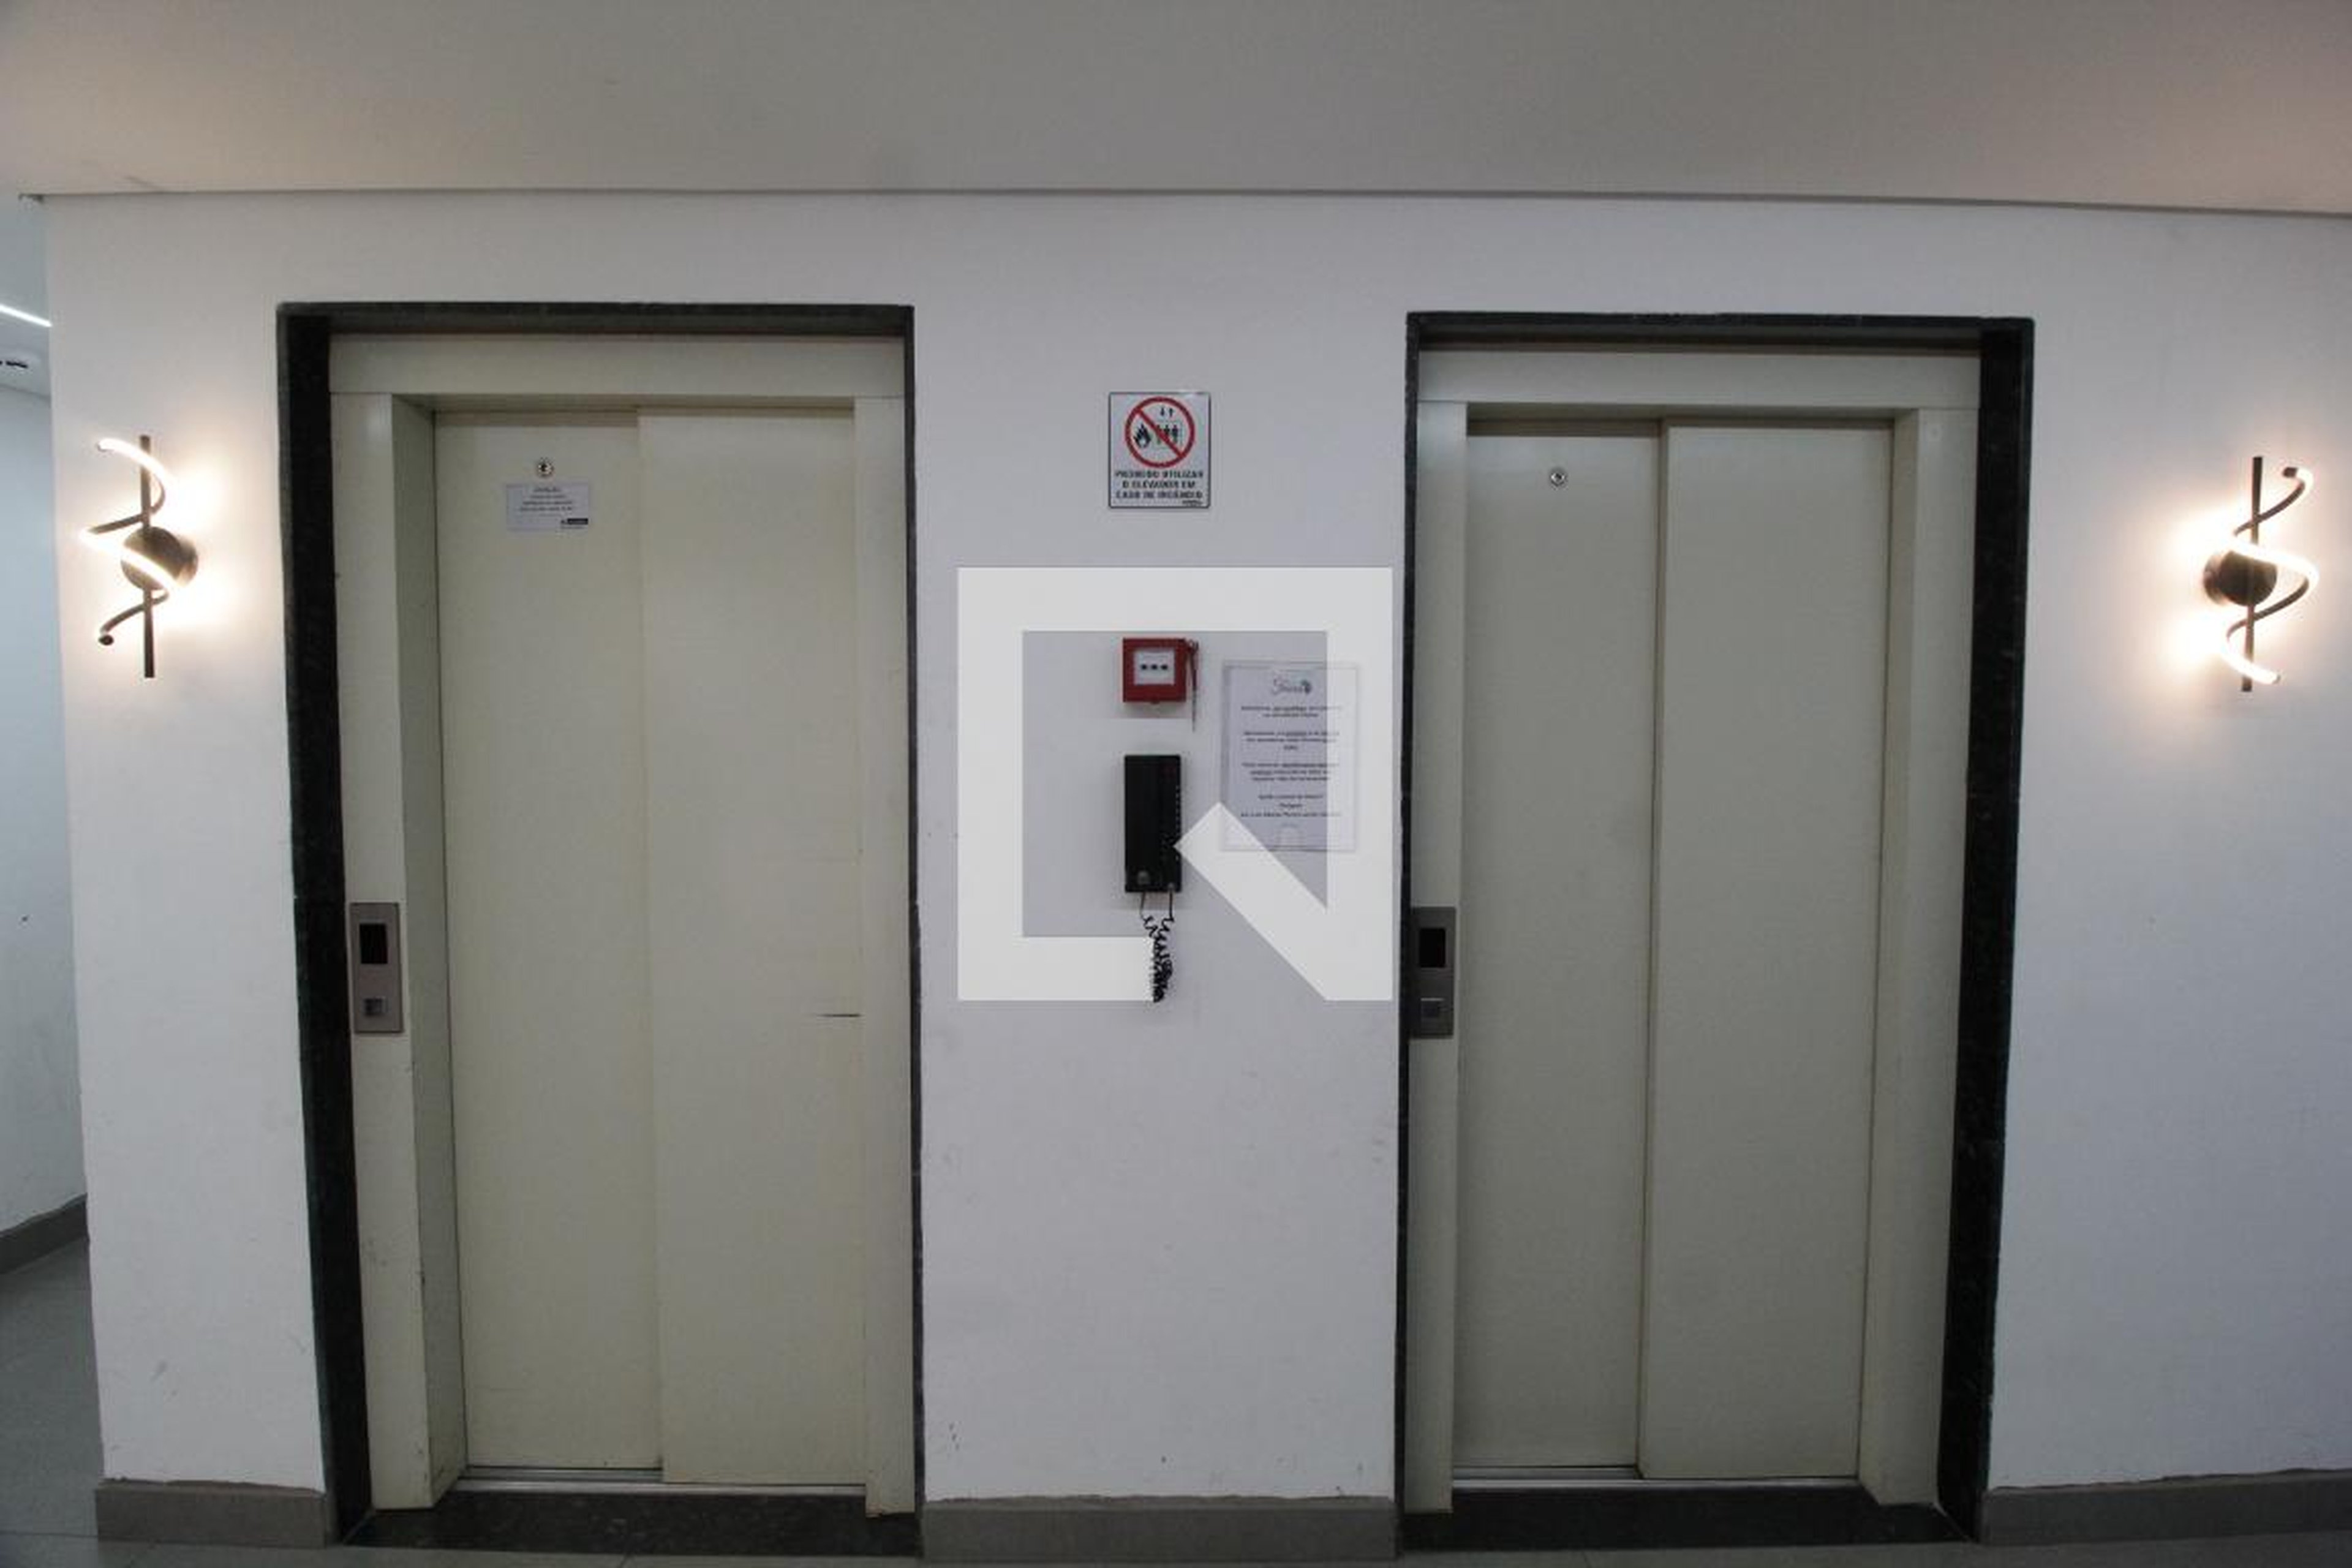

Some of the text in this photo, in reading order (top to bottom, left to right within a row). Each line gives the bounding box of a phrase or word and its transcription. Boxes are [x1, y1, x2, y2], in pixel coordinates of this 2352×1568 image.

[1162, 470, 1204, 478] UTILIZAR
[1132, 480, 1180, 489] ELEVADOR
[1182, 480, 1196, 489] EM
[1115, 490, 1140, 499] CASO
